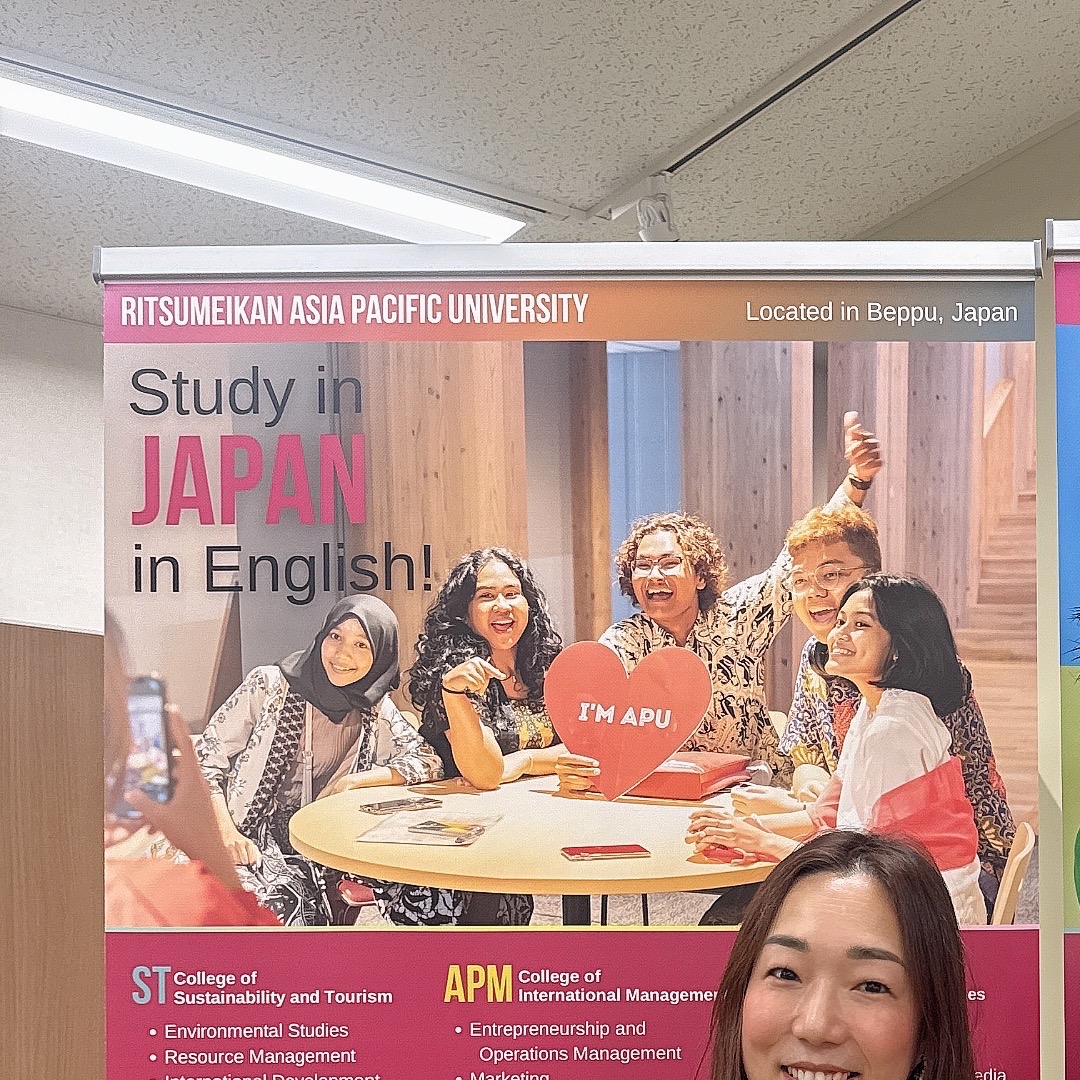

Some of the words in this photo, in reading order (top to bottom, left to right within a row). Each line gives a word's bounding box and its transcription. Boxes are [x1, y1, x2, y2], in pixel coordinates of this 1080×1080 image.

[120, 294, 284, 327] RITSUMEIKAN
[289, 294, 345, 325] ASIA
[351, 293, 442, 325] PACIFIC
[448, 292, 589, 324] UNIVERSITY
[745, 301, 833, 322] Located
[840, 301, 860, 322] in
[867, 301, 944, 327] Beppu,
[951, 302, 1019, 326] Japan
[129, 364, 296, 428] Study
[316, 364, 363, 414] in
[131, 433, 366, 526] JAPAN
[133, 543, 180, 593] in
[205, 543, 434, 606] English!
[578, 702, 615, 724] I'M
[619, 708, 672, 729] APU
[131, 965, 172, 1005] ST
[173, 971, 236, 988] College
[240, 970, 258, 985] of
[443, 963, 513, 1004] APM
[518, 969, 579, 987] College
[583, 968, 603, 984] of
[173, 990, 286, 1008] Sustainability
[289, 990, 320, 1005] and
[324, 989, 394, 1004] Tourism
[518, 988, 622, 1002] International
[164, 1023, 283, 1040] Environmental
[287, 1023, 349, 1039] Studies
[469, 1020, 610, 1039] Entrepreneurship
[615, 1020, 647, 1036] and
[165, 1049, 244, 1065] Resource
[249, 1048, 357, 1067] Management
[478, 1046, 569, 1064] Operations
[573, 1046, 682, 1064] Management
